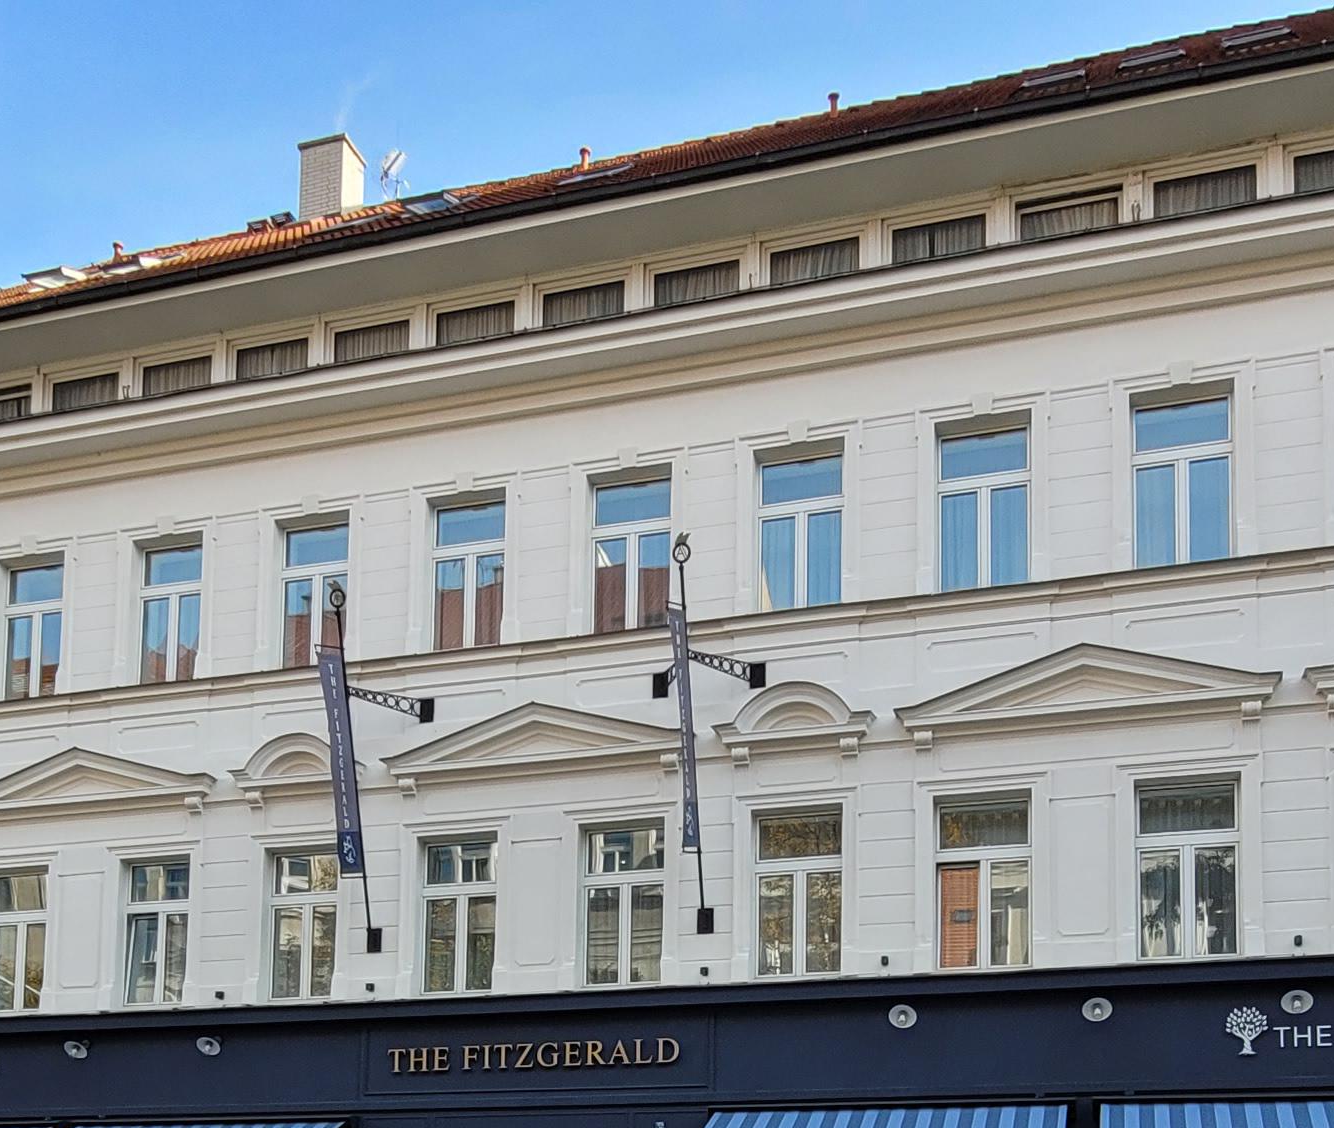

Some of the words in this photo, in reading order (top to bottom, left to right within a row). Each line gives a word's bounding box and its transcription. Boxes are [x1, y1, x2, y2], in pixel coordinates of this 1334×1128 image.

[327, 663, 338, 700] THE
[333, 708, 351, 830] FITZGERALD
[1273, 1025, 1332, 1047] THE
[387, 1047, 451, 1073] THE
[461, 1037, 680, 1071] FITZGERALD
